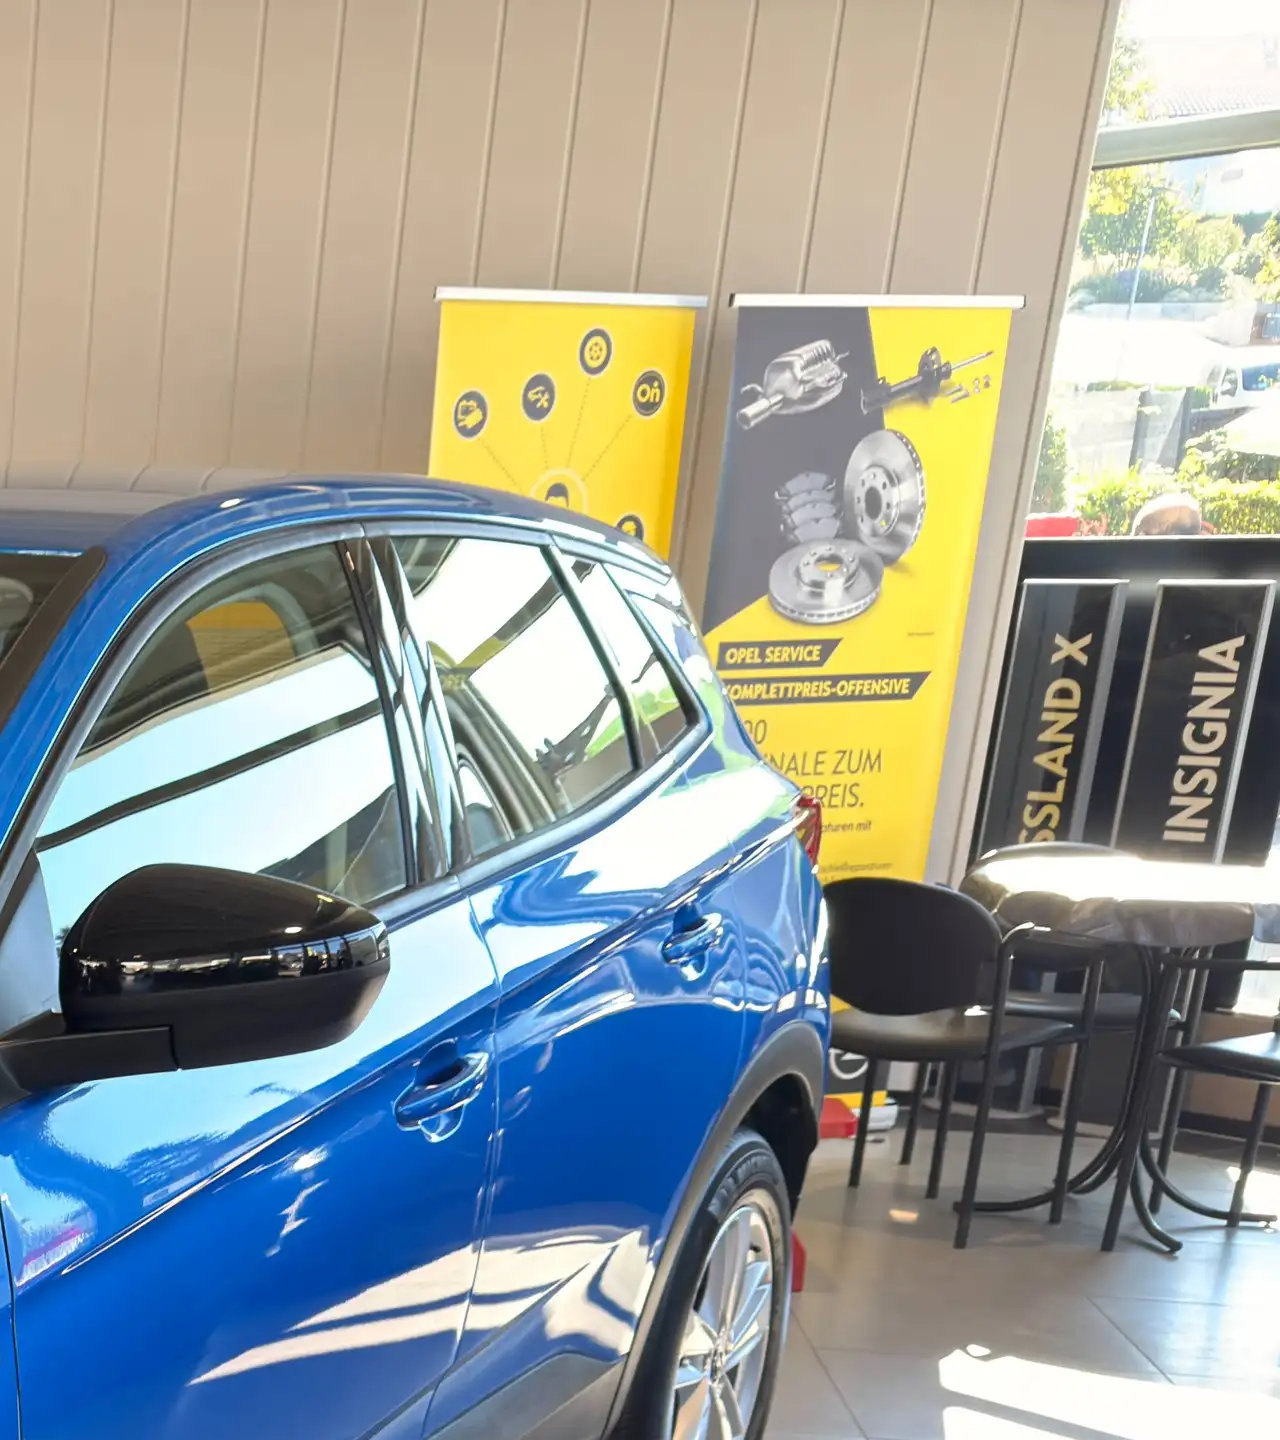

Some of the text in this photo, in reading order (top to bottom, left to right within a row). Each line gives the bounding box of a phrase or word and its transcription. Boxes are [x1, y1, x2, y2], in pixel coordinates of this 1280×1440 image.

[725, 645, 822, 664] OPEL SERVICE
[1050, 632, 1093, 667] X
[1162, 635, 1246, 843] INSIGNIA
[832, 748, 882, 775] ZUM
